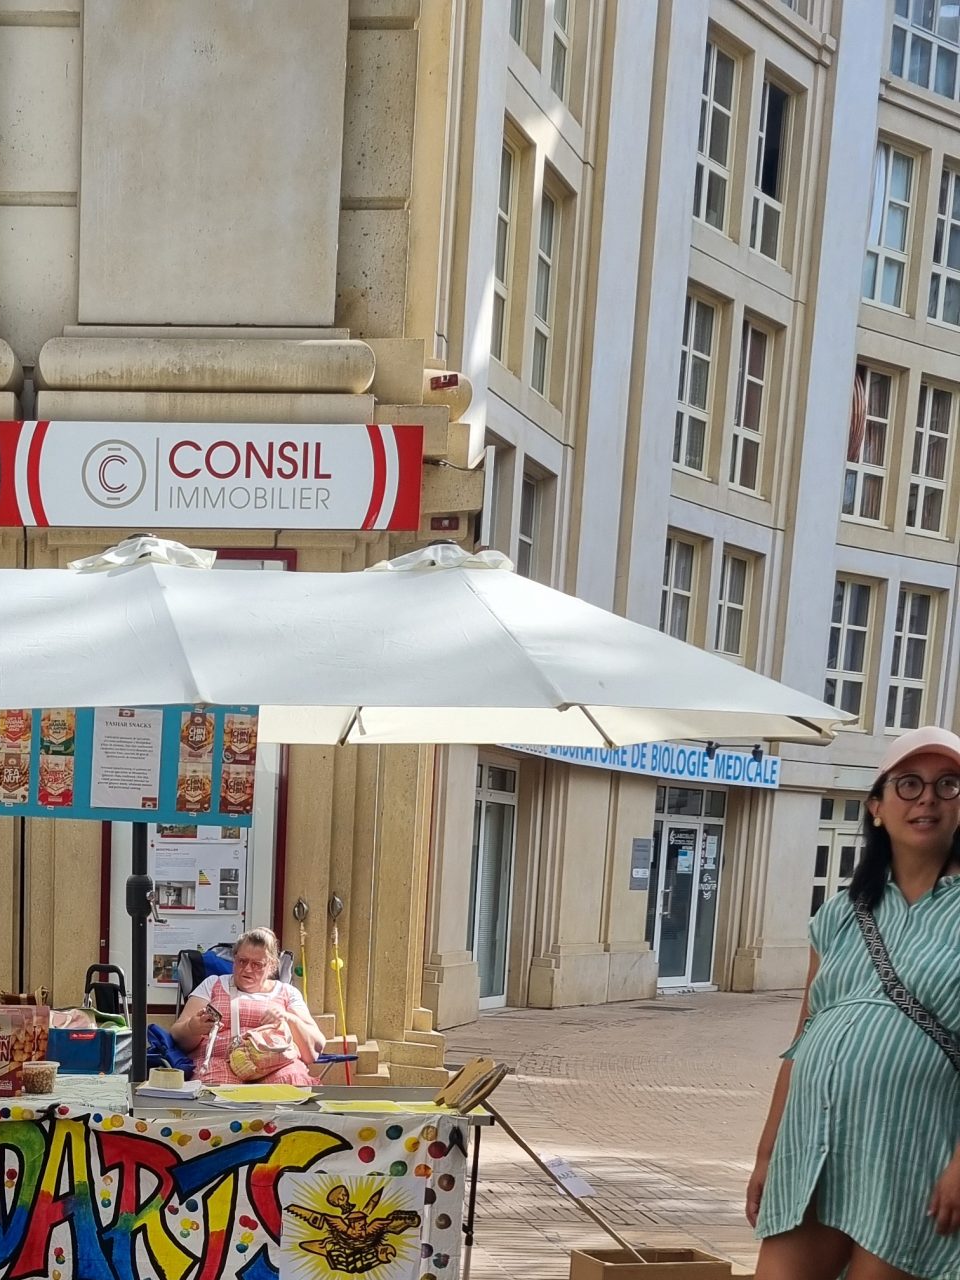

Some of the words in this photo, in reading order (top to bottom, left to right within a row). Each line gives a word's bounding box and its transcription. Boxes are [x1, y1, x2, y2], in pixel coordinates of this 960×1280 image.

[169, 440, 332, 480] CONSIL
[168, 486, 330, 510] IMMOBILIER
[189, 726, 205, 735] CHIN
[631, 742, 647, 769] DE
[651, 744, 708, 778] BIOLOGIE
[714, 753, 778, 784] MEDICALE
[3, 775, 20, 783] NUT
